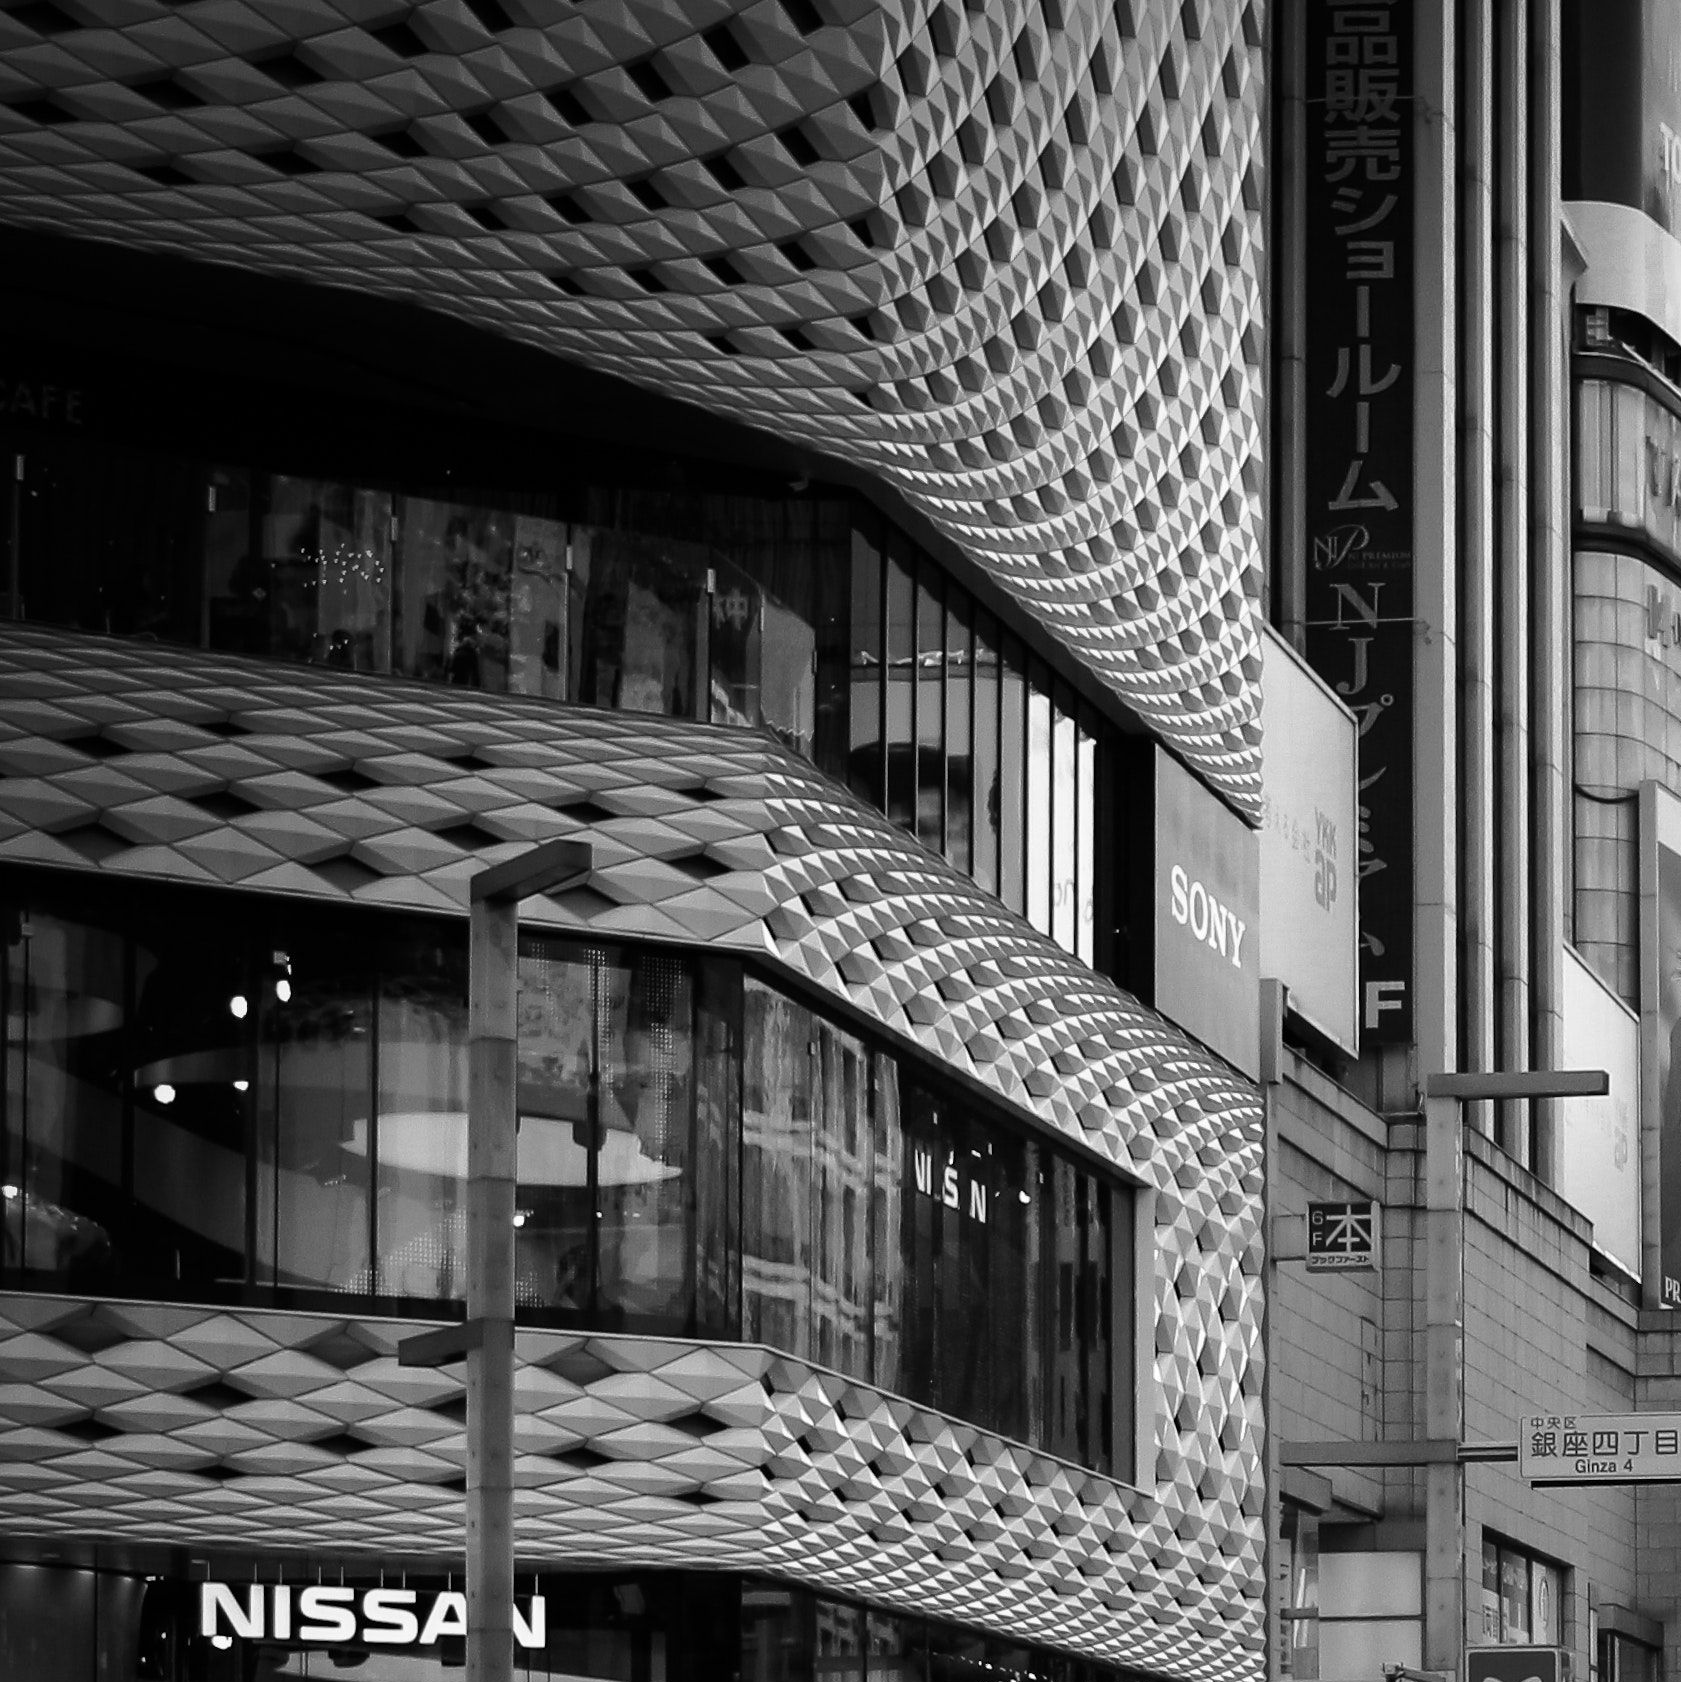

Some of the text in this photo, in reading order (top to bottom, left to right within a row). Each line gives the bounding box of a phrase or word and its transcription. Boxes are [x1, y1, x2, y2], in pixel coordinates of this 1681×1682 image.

[1325, 0, 1403, 513] 品販売ショールーム
[0, 376, 86, 426] AFE
[1169, 863, 1247, 970] SONY
[1325, 1203, 1374, 1253] 本
[1530, 1416, 1577, 1430] 中央区
[1530, 1430, 1679, 1459] 銀座四丁目
[1575, 1459, 1634, 1474] Ginza 4
[200, 1580, 547, 1649] NISSAN
